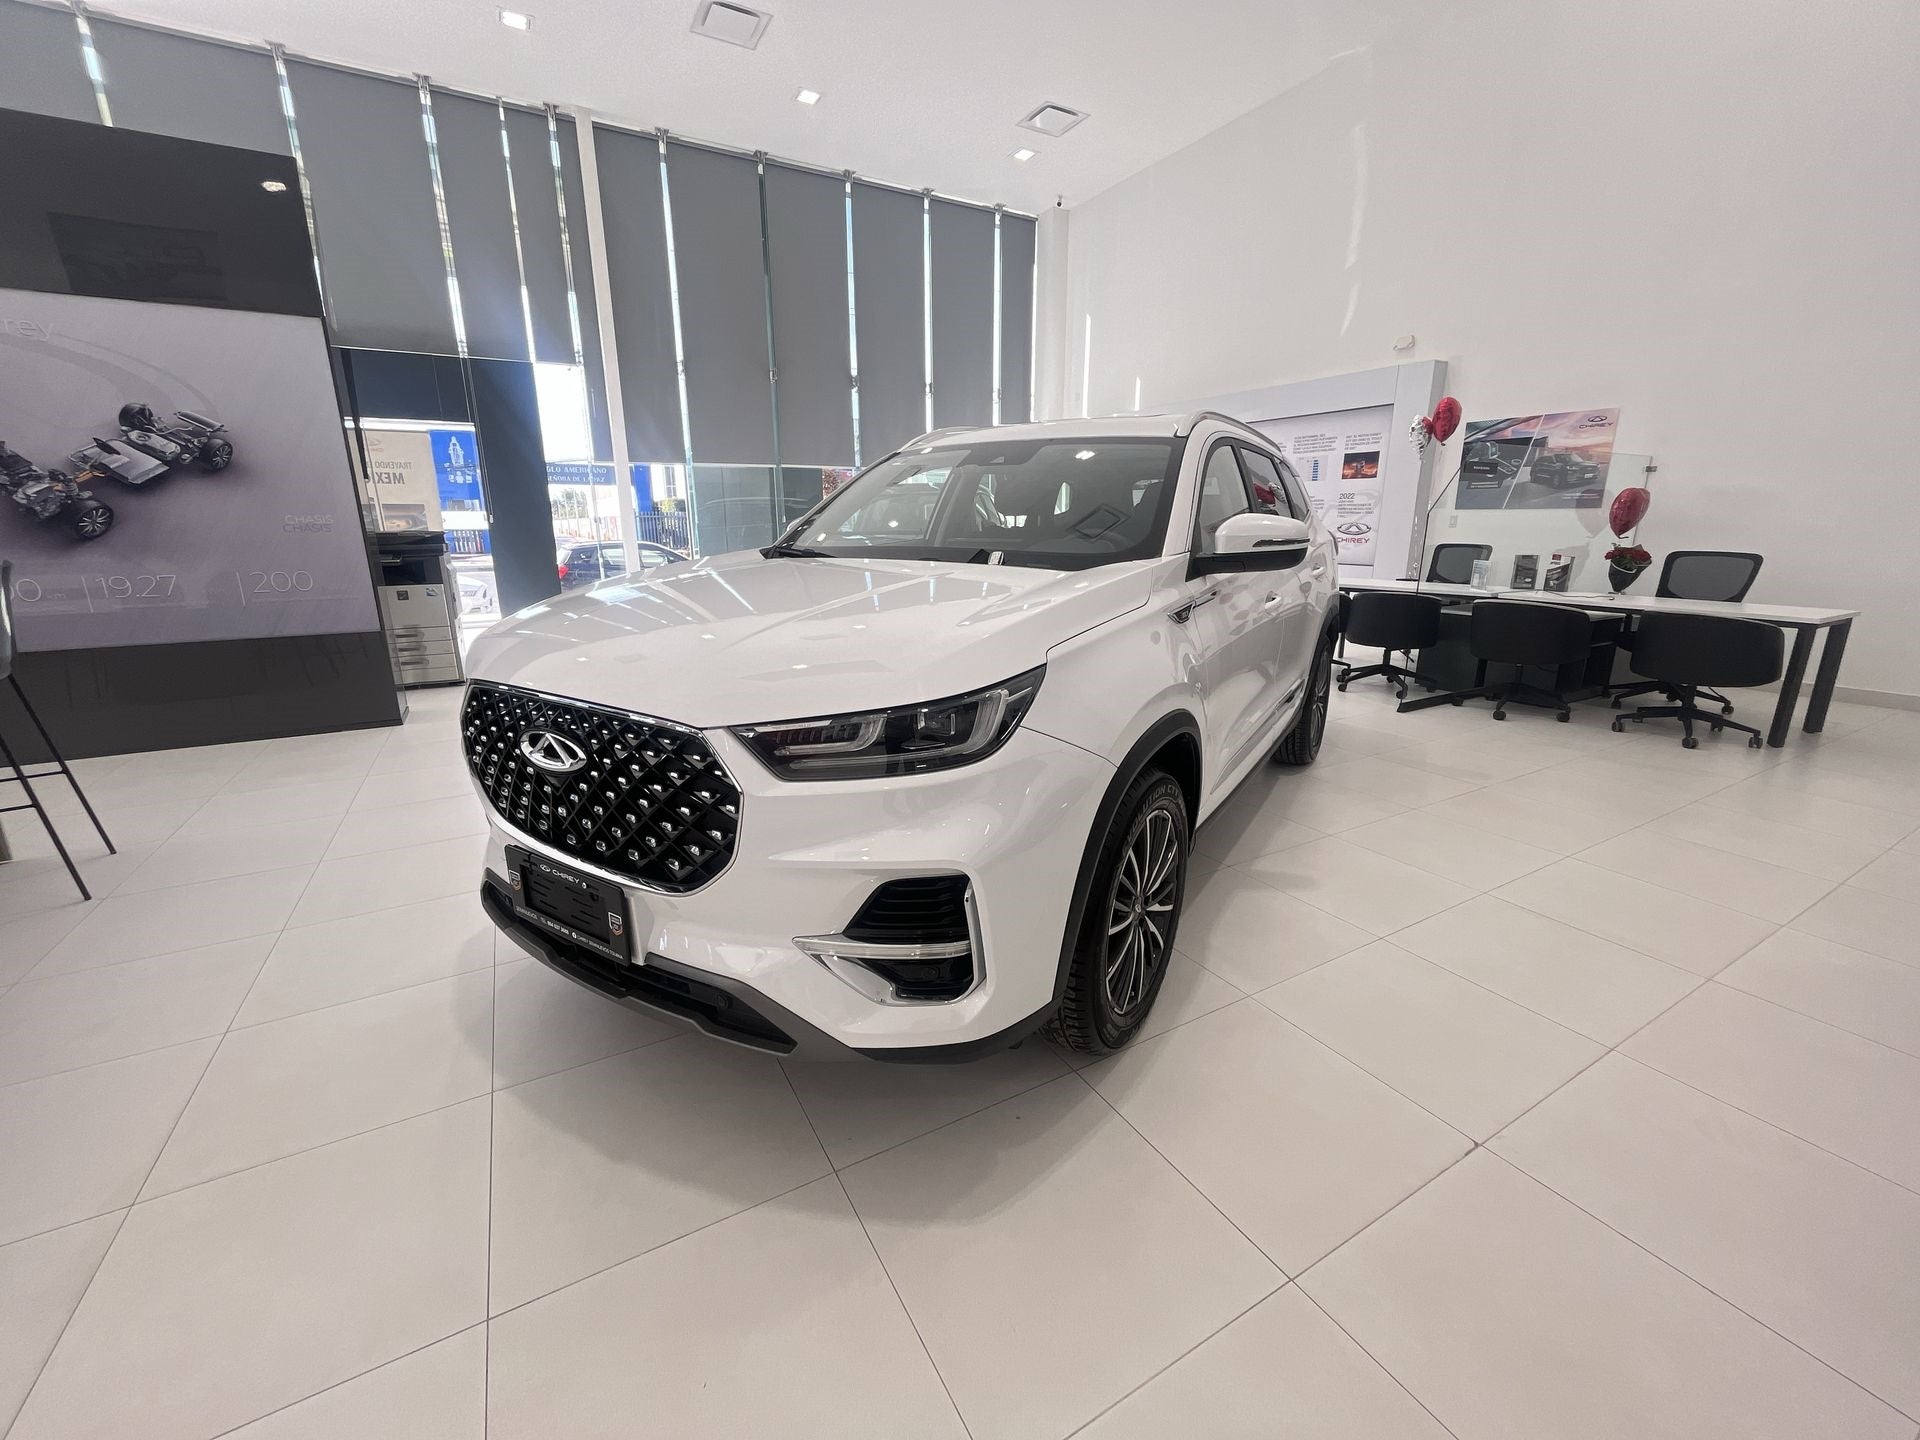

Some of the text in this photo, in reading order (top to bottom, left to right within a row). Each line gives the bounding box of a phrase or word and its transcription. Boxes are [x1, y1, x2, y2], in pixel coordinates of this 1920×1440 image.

[1338, 492, 1355, 500] 2022
[284, 514, 334, 525] CHASIS
[1336, 536, 1370, 544] CHIREY
[95, 574, 177, 599] 19.27
[249, 570, 313, 593] 200
